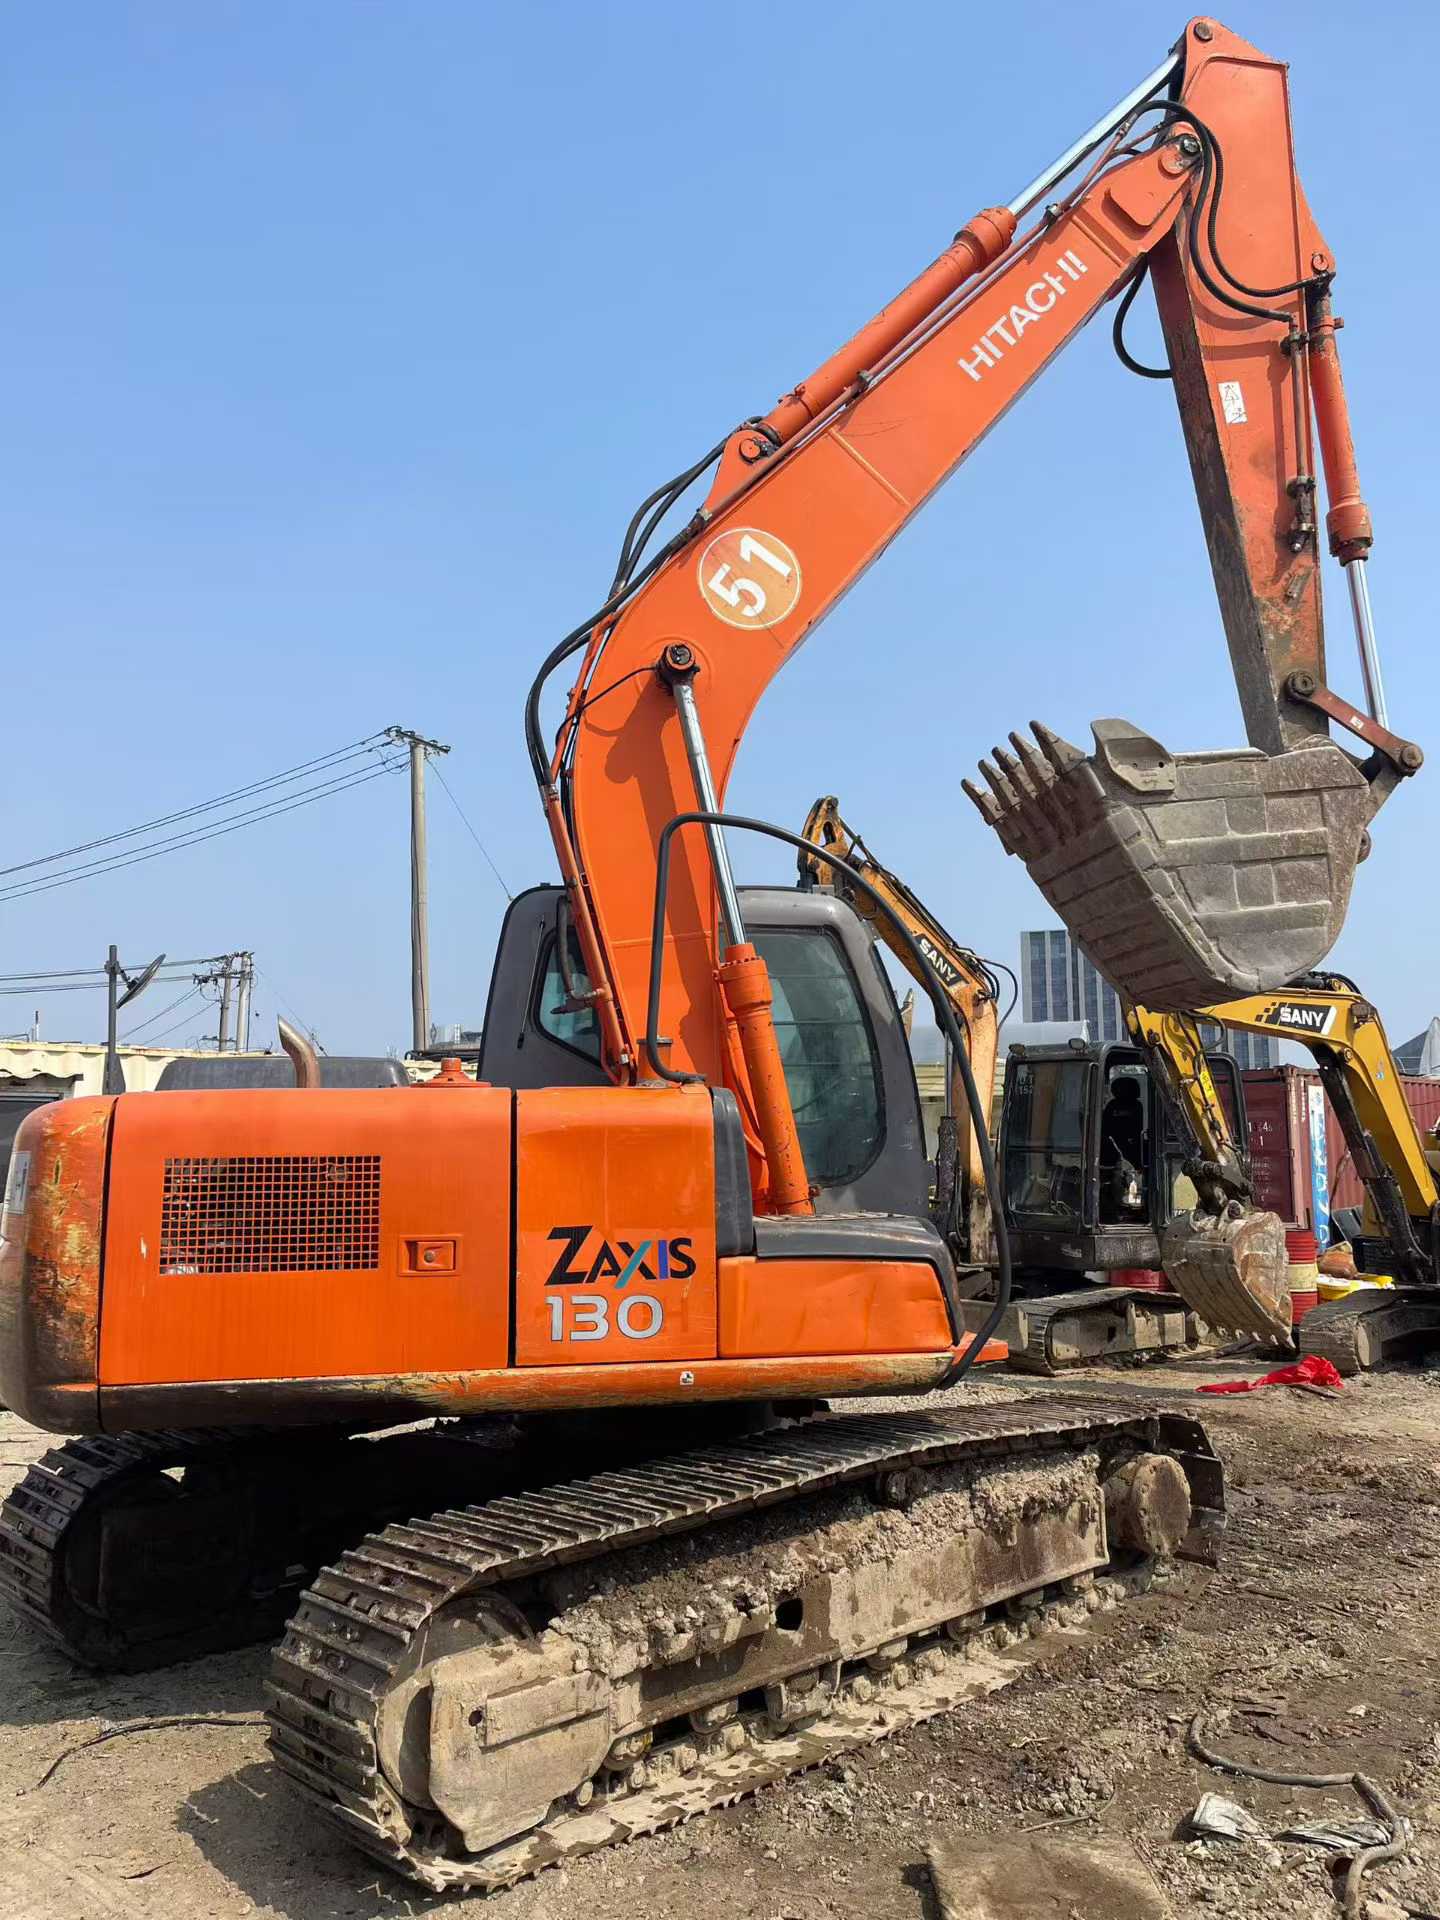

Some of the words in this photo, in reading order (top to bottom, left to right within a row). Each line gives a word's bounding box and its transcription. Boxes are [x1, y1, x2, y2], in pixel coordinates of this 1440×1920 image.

[957, 250, 1088, 382] HITACHI
[707, 534, 792, 617] 51
[920, 938, 957, 982] SANY
[1280, 1006, 1323, 1027] SANY
[544, 1225, 697, 1289] ZAXIS
[545, 1295, 664, 1341] 130
